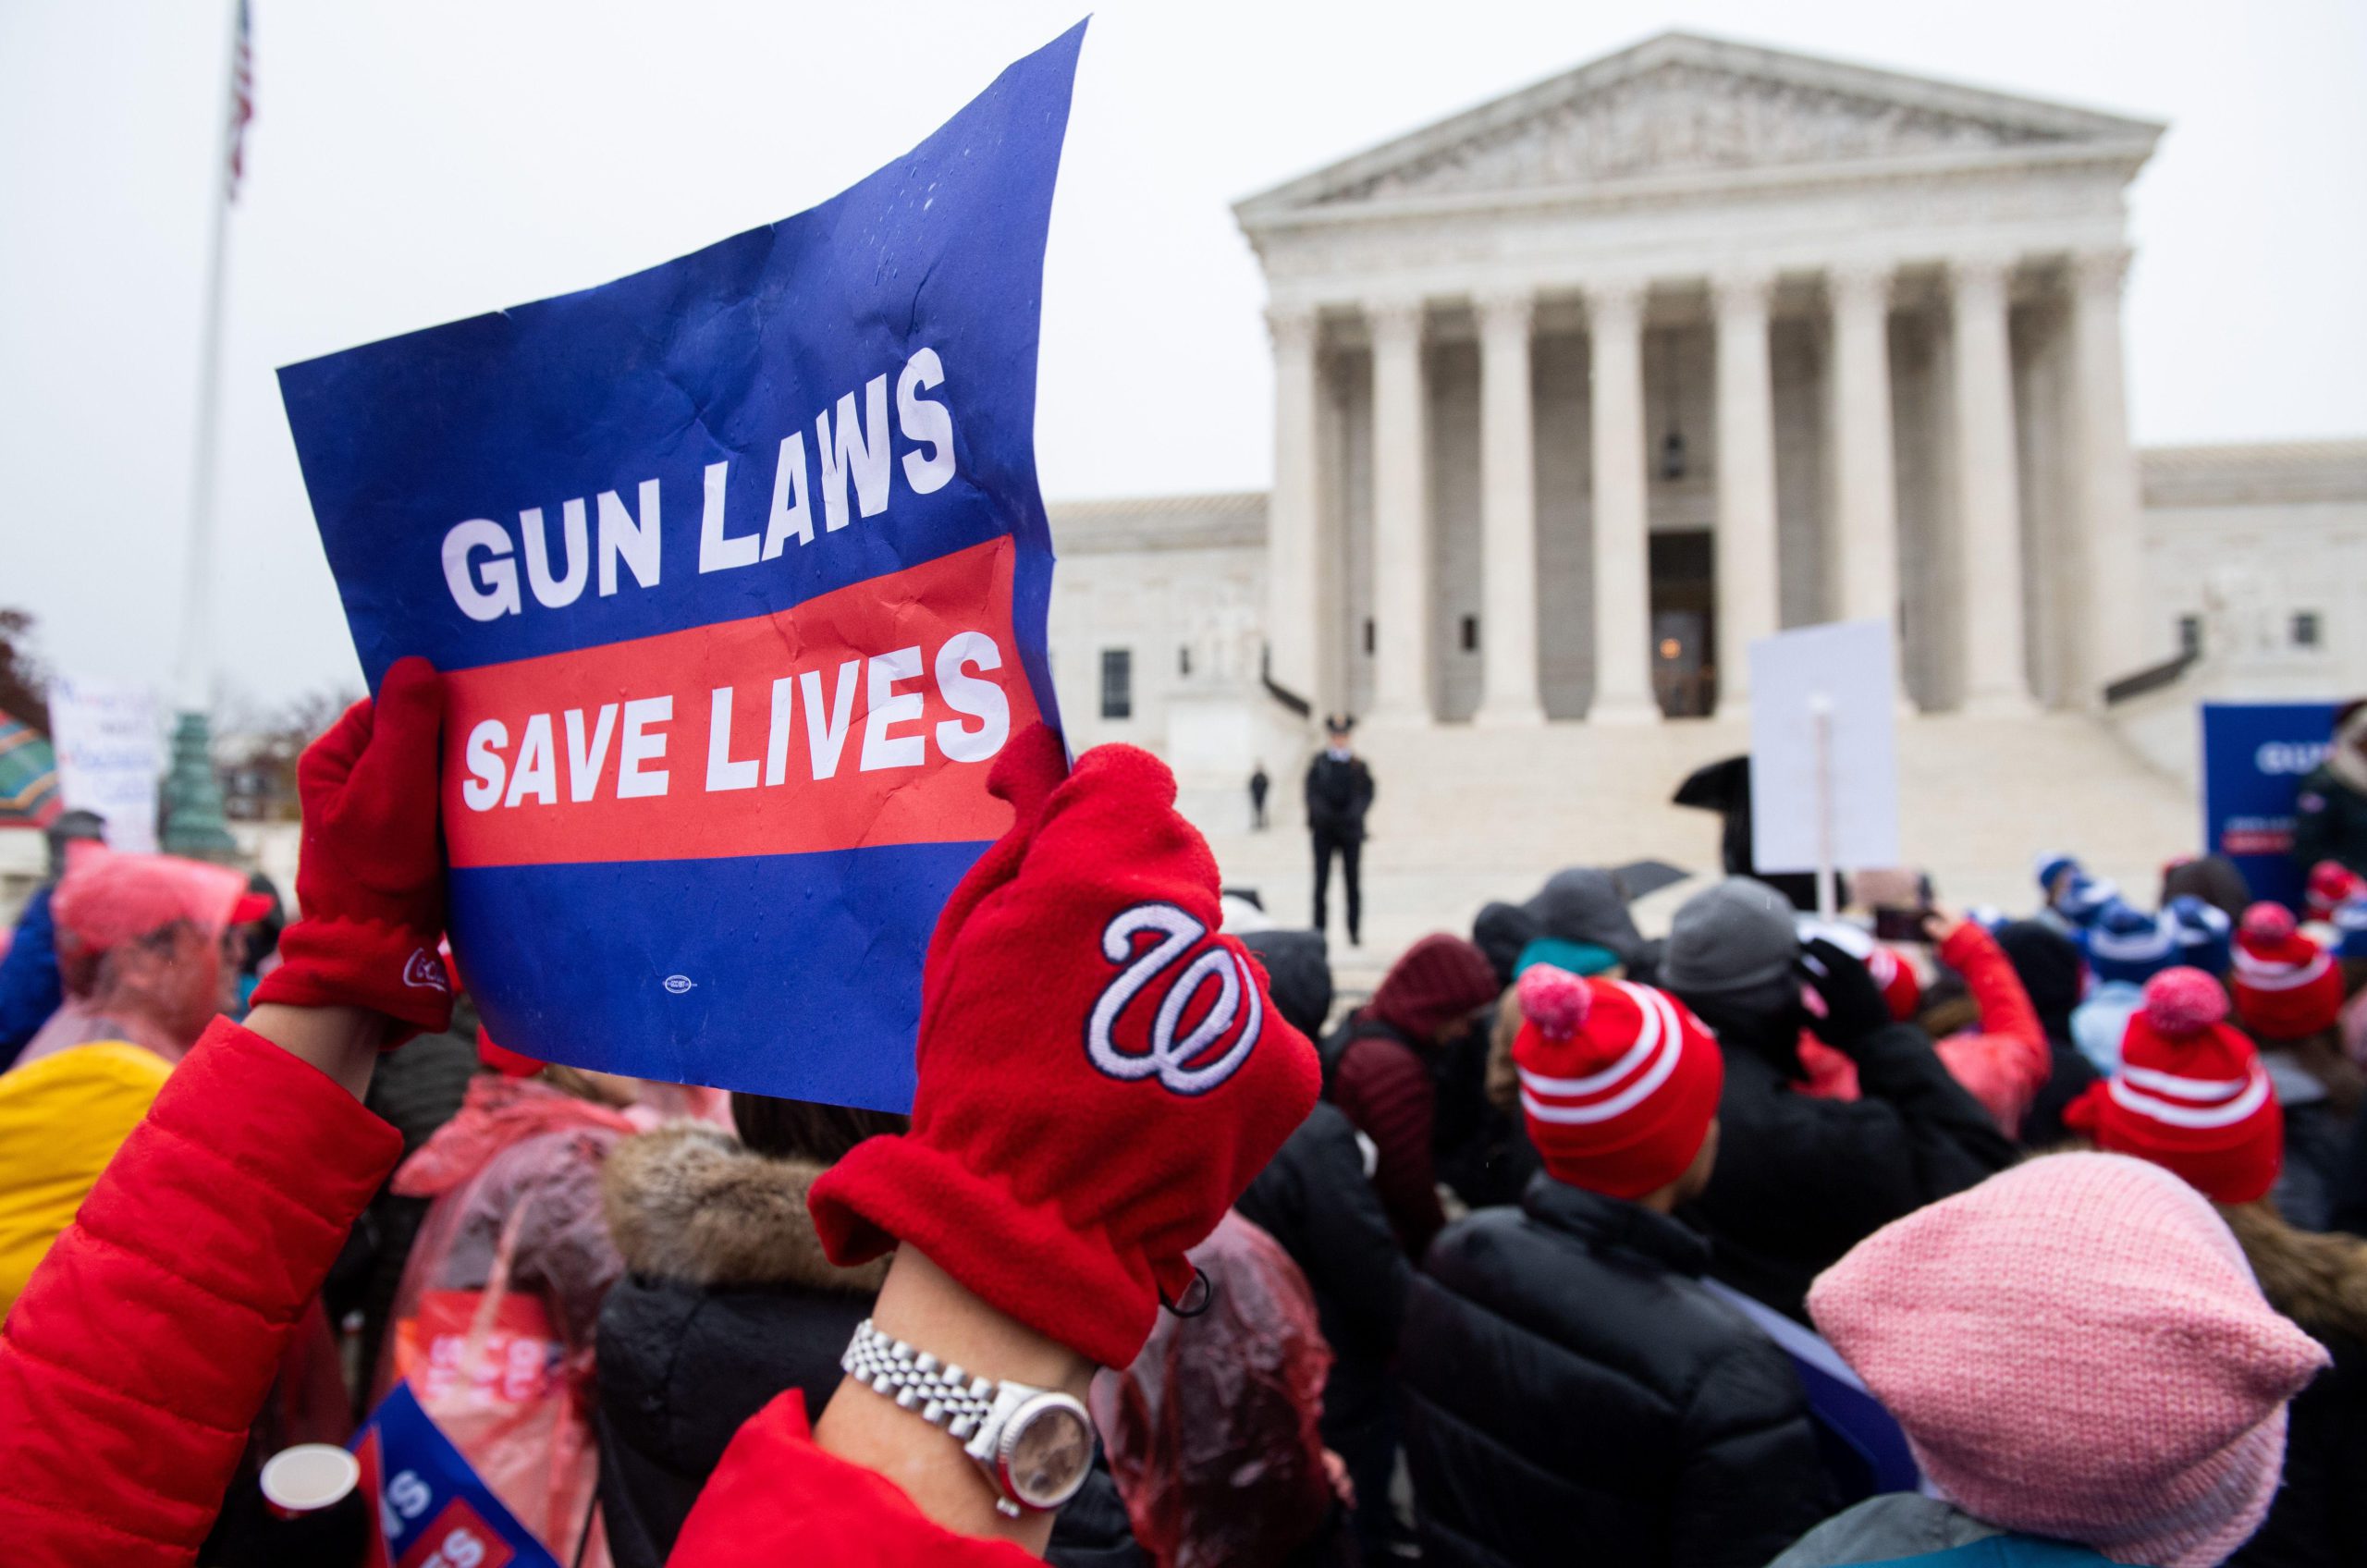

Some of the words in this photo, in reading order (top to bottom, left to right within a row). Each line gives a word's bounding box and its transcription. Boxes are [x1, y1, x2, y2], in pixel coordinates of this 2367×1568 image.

[441, 478, 662, 622] GUN
[698, 347, 956, 575] LAWS
[462, 693, 674, 813] SAVE
[705, 631, 1011, 793] LIVES
[1085, 902, 1262, 1094] W
